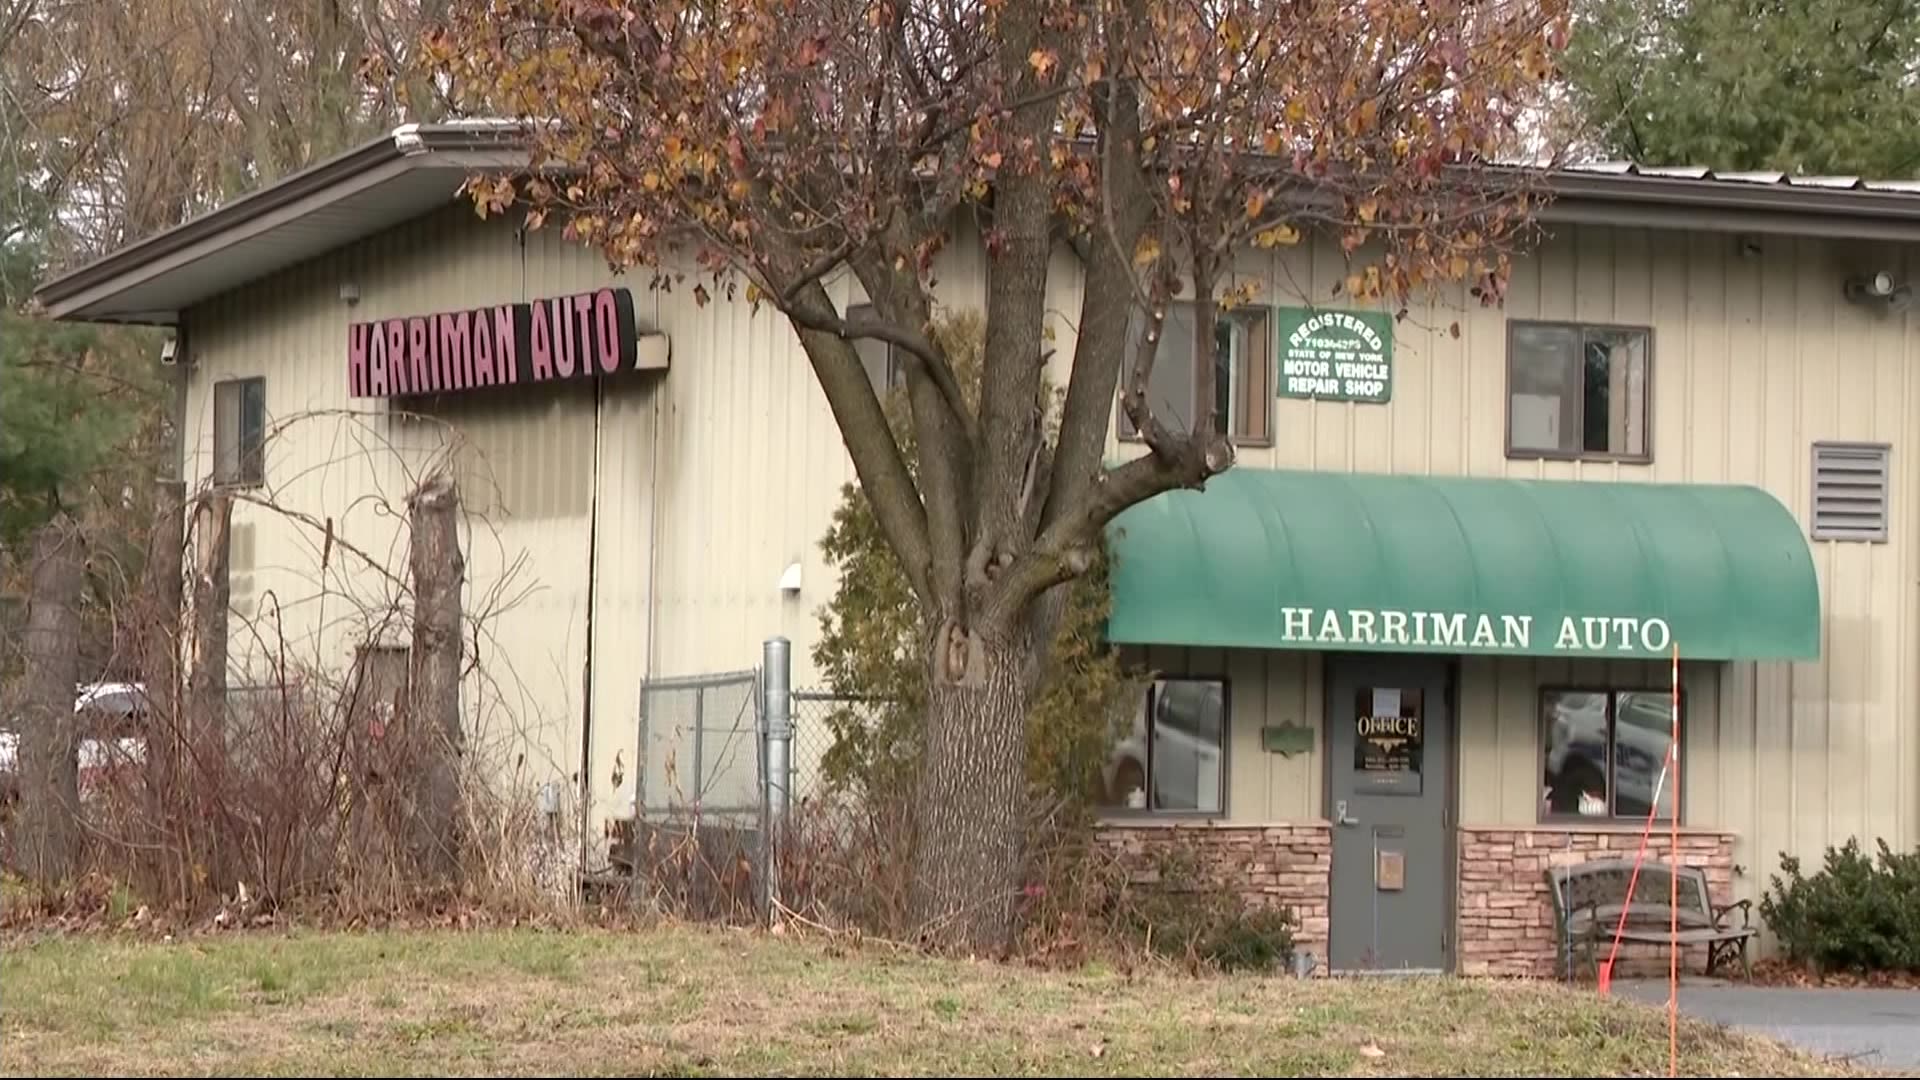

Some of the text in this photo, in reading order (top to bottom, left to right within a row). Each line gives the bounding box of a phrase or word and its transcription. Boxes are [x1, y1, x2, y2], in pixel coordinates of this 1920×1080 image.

[1289, 313, 1382, 350] REGISTERED
[350, 288, 620, 398] HARRIMAN AUTO
[1288, 349, 1383, 362] STATE OF NEW YORK
[1284, 360, 1388, 379] MOTOR VEHICLE
[1288, 377, 1383, 396] REPAIR SHOP
[1281, 607, 1671, 652] HARRIMAN AUTO
[1358, 716, 1418, 737] OFFICE
